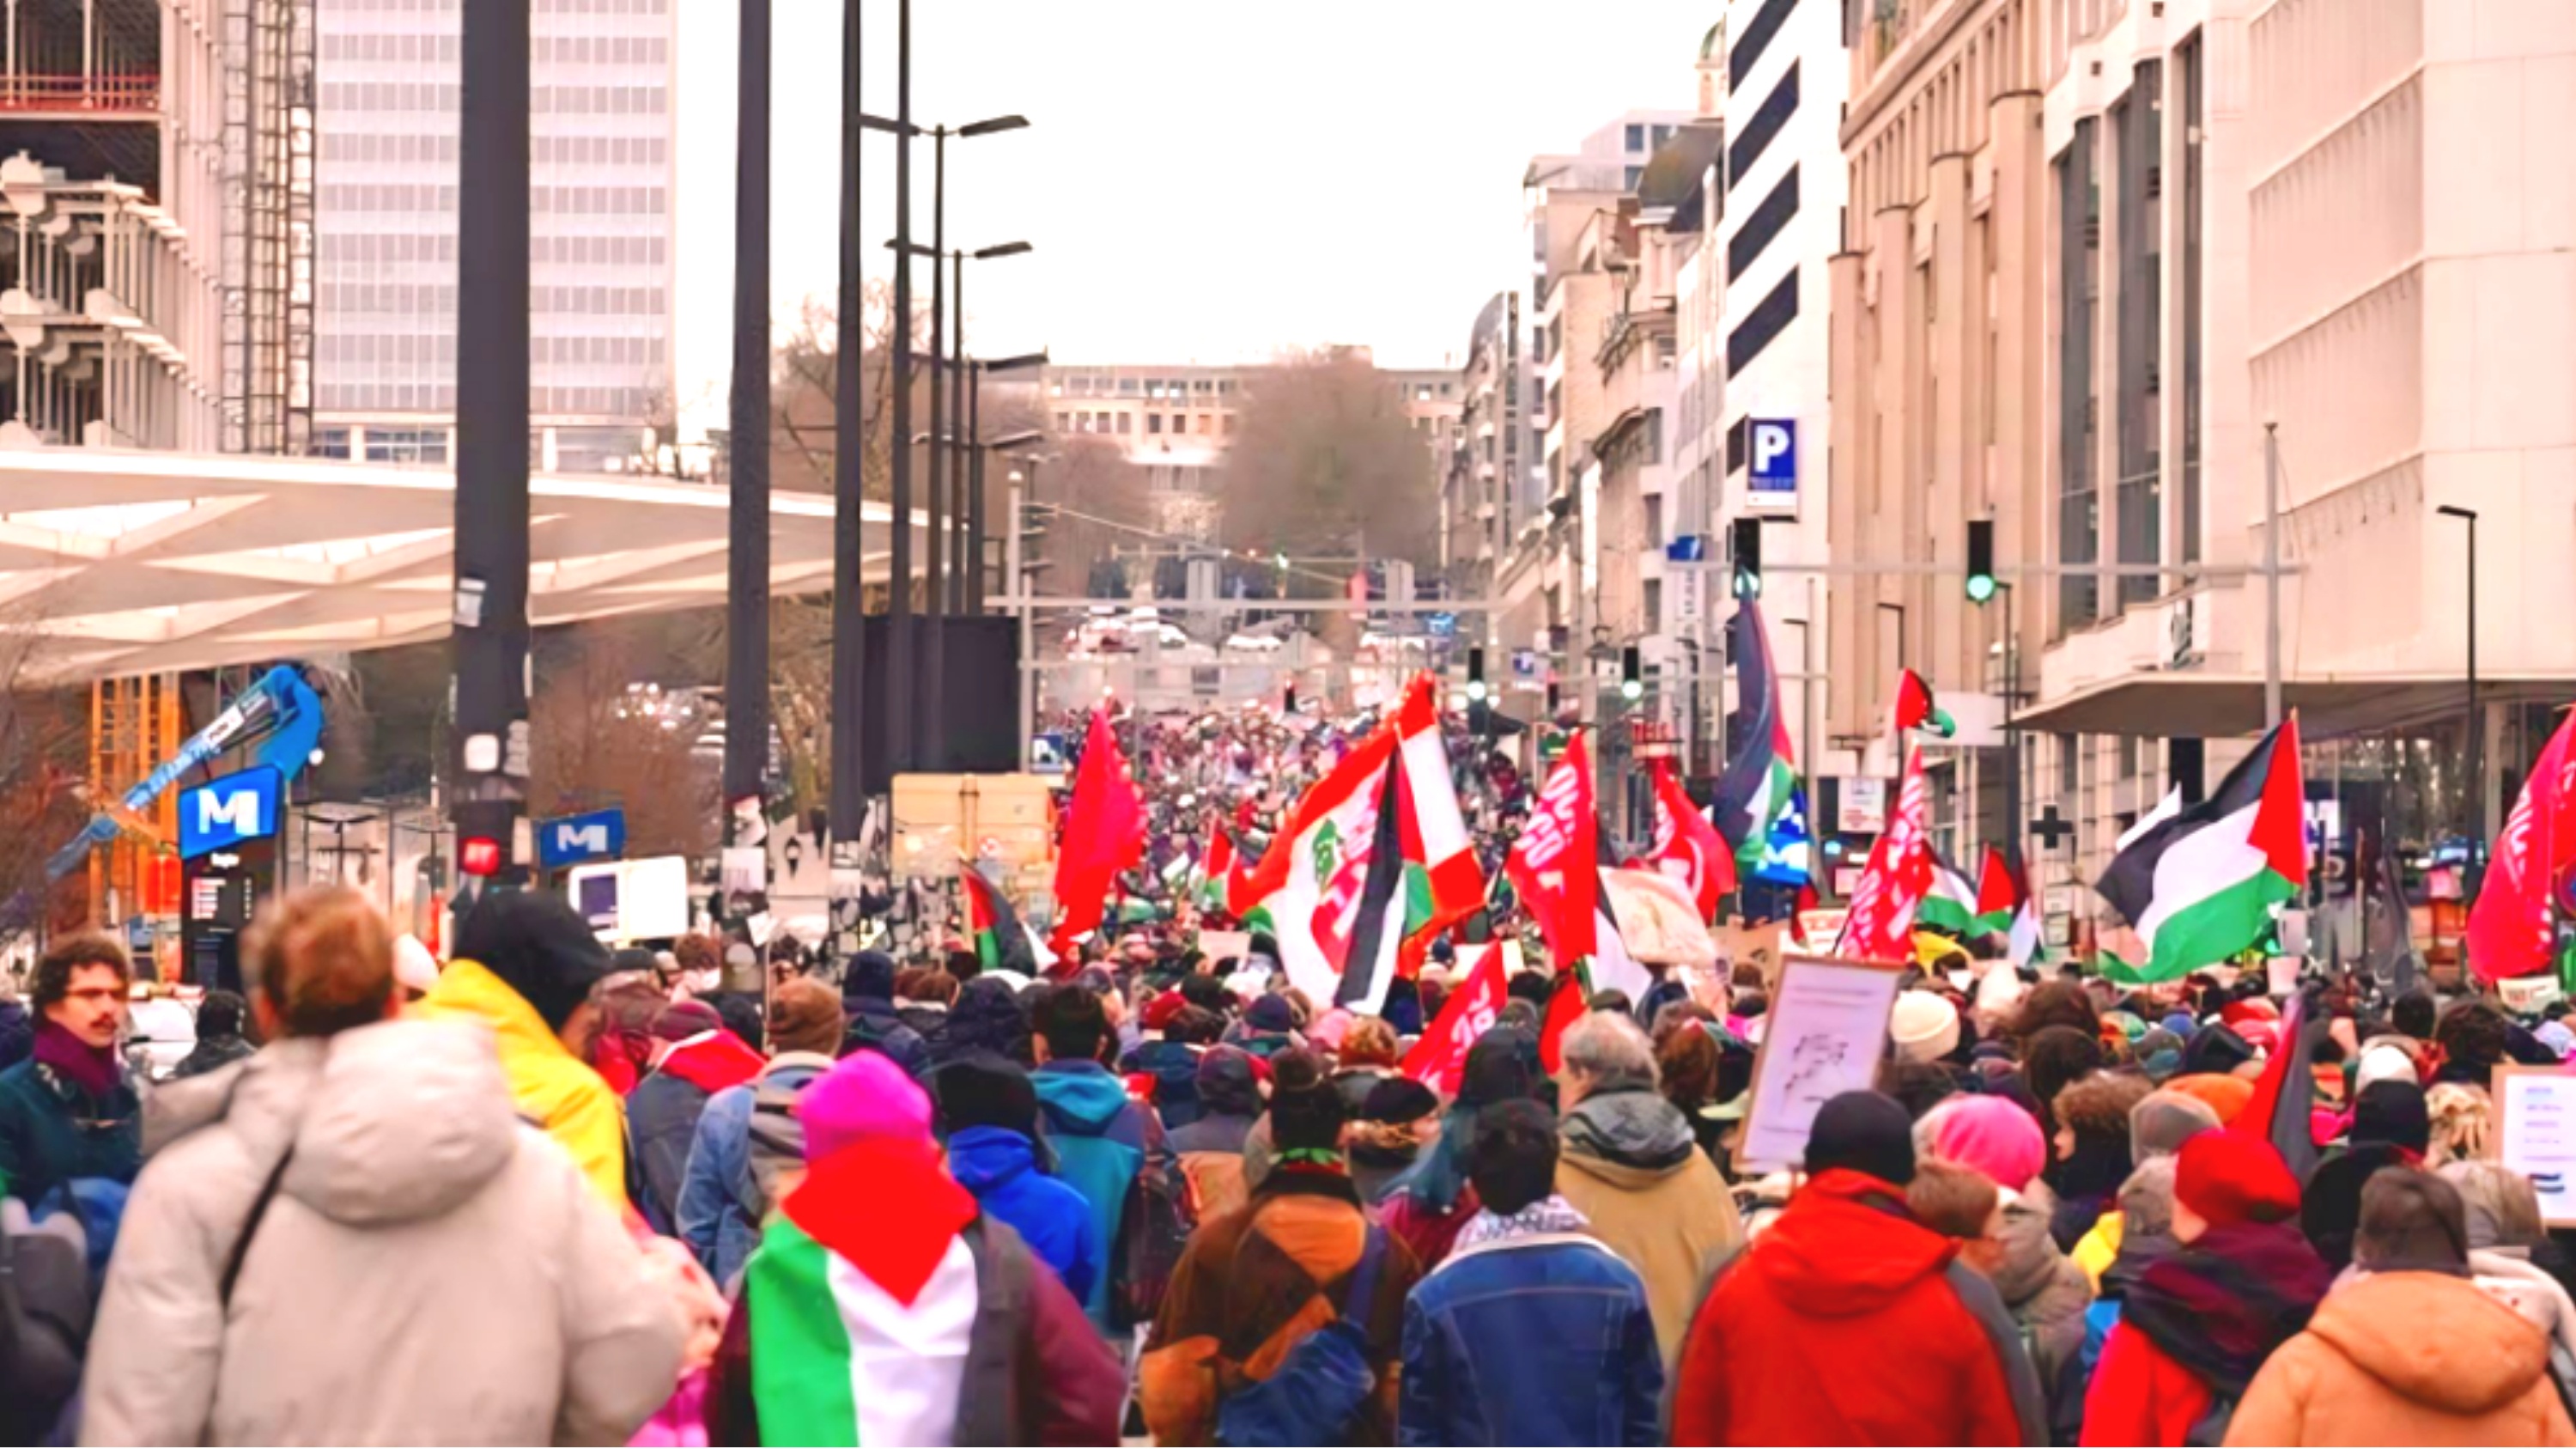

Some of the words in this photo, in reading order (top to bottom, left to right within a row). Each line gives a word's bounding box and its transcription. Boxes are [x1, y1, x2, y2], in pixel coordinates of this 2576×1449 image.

[1755, 424, 1789, 472] P
[198, 788, 260, 837] M
[557, 825, 606, 850] M
